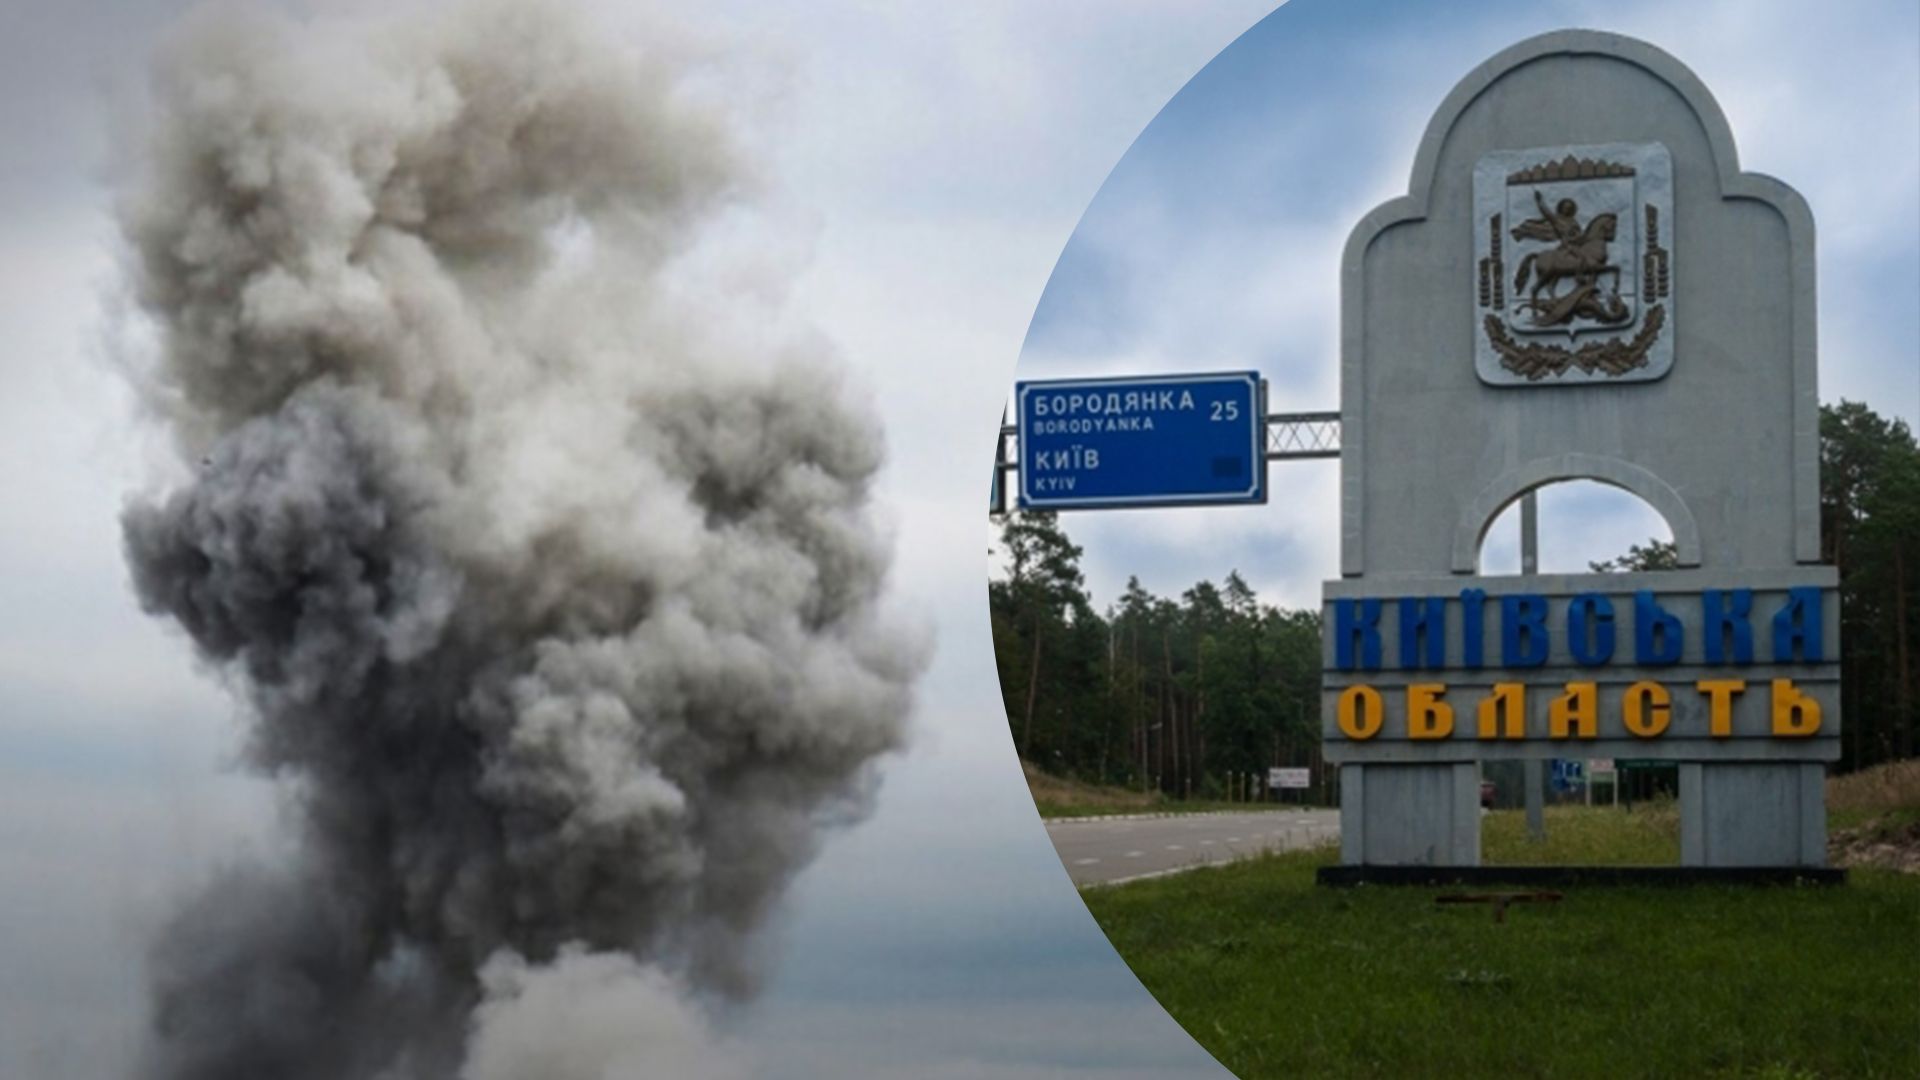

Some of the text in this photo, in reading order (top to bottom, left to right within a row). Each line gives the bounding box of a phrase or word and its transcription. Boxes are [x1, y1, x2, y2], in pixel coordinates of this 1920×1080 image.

[1034, 390, 1239, 421] БОРОДЯНКА 25
[1033, 417, 1154, 435] BORODYANKA
[1035, 445, 1100, 470] КИЇВ
[1035, 477, 1076, 491] KYIV
[1334, 586, 1824, 671] КИЇВСЬКА
[1337, 677, 1822, 740] ОБЛАСТЬ
